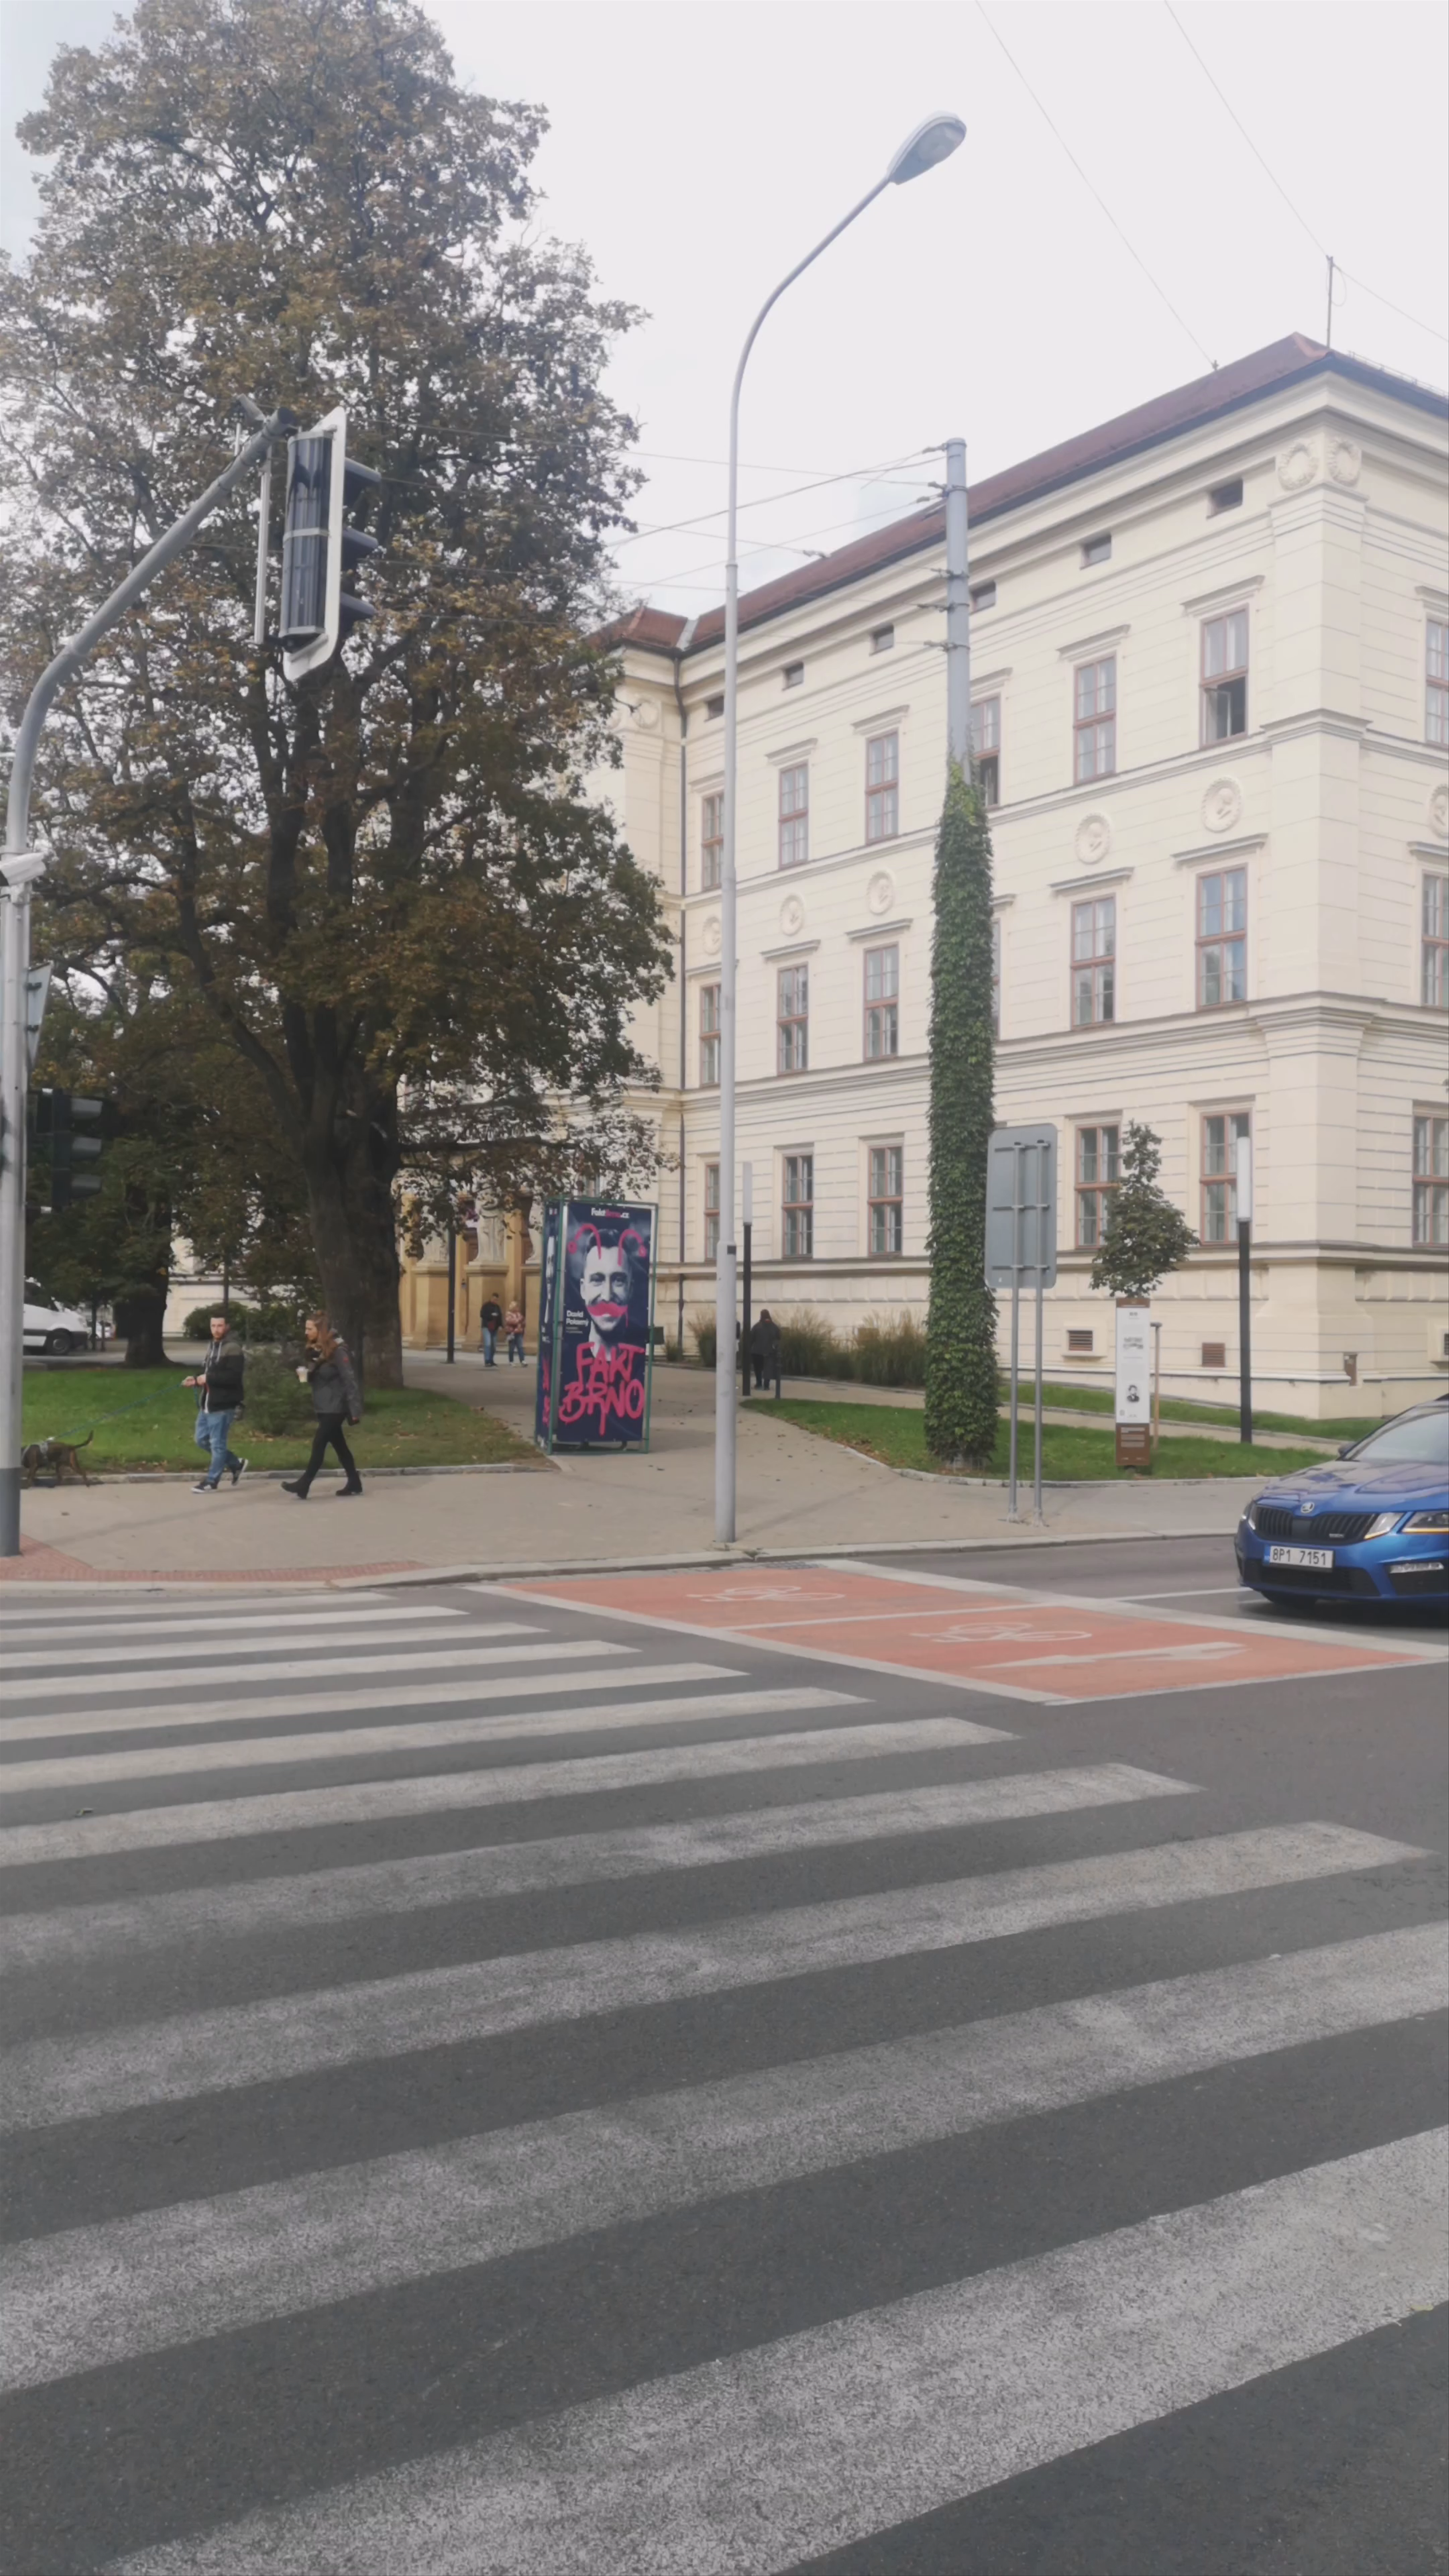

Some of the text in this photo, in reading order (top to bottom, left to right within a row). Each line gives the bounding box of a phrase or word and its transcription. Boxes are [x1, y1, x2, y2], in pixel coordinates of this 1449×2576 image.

[577, 1342, 645, 1384] FAKT
[559, 1379, 645, 1435] BRNO
[1273, 1548, 1326, 1566] 8P1 7151
